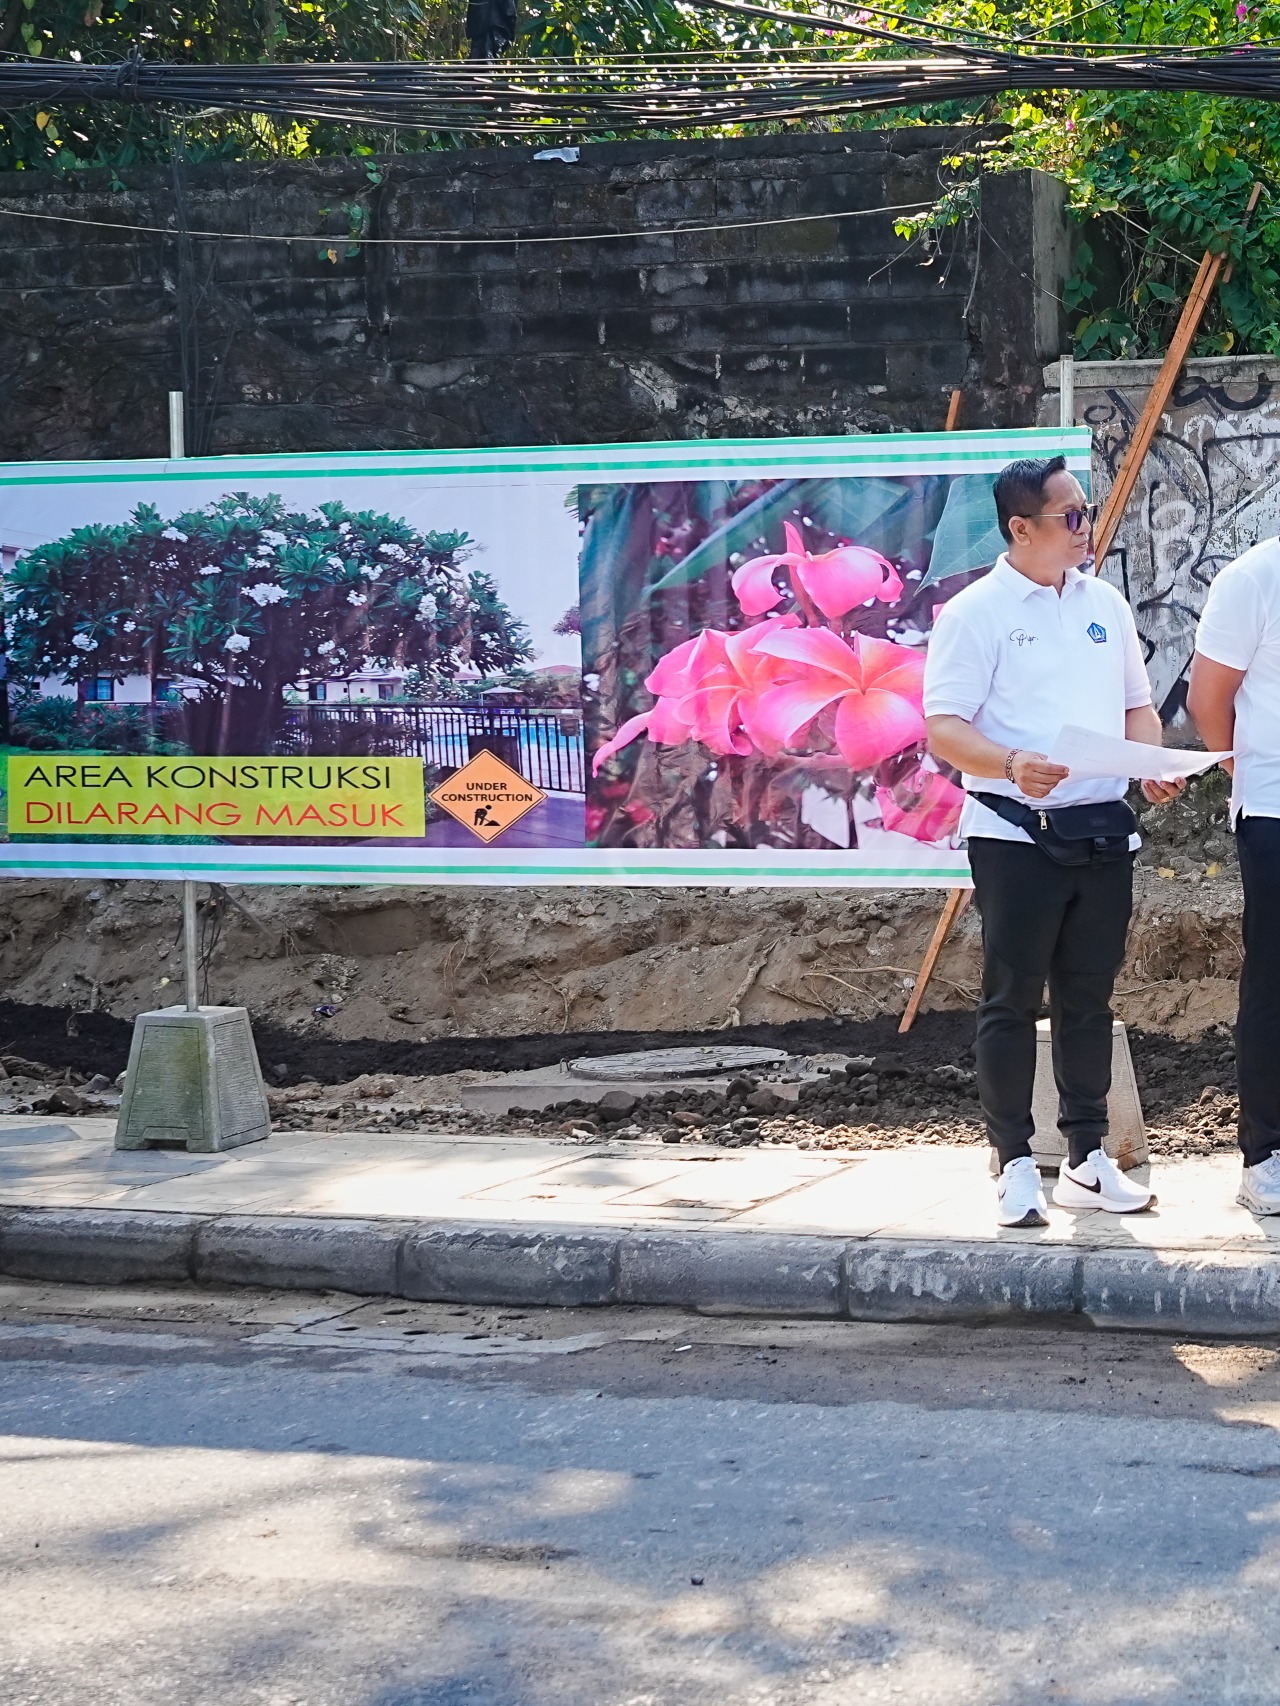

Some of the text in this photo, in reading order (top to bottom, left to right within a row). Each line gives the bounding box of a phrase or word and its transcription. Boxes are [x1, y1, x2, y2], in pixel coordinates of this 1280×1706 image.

[24, 765, 391, 790] AREA KONSTRUKSI
[466, 782, 508, 791] UNDER
[441, 793, 533, 802] CONSTRUCTION
[26, 801, 405, 828] DILARANG MASUK
